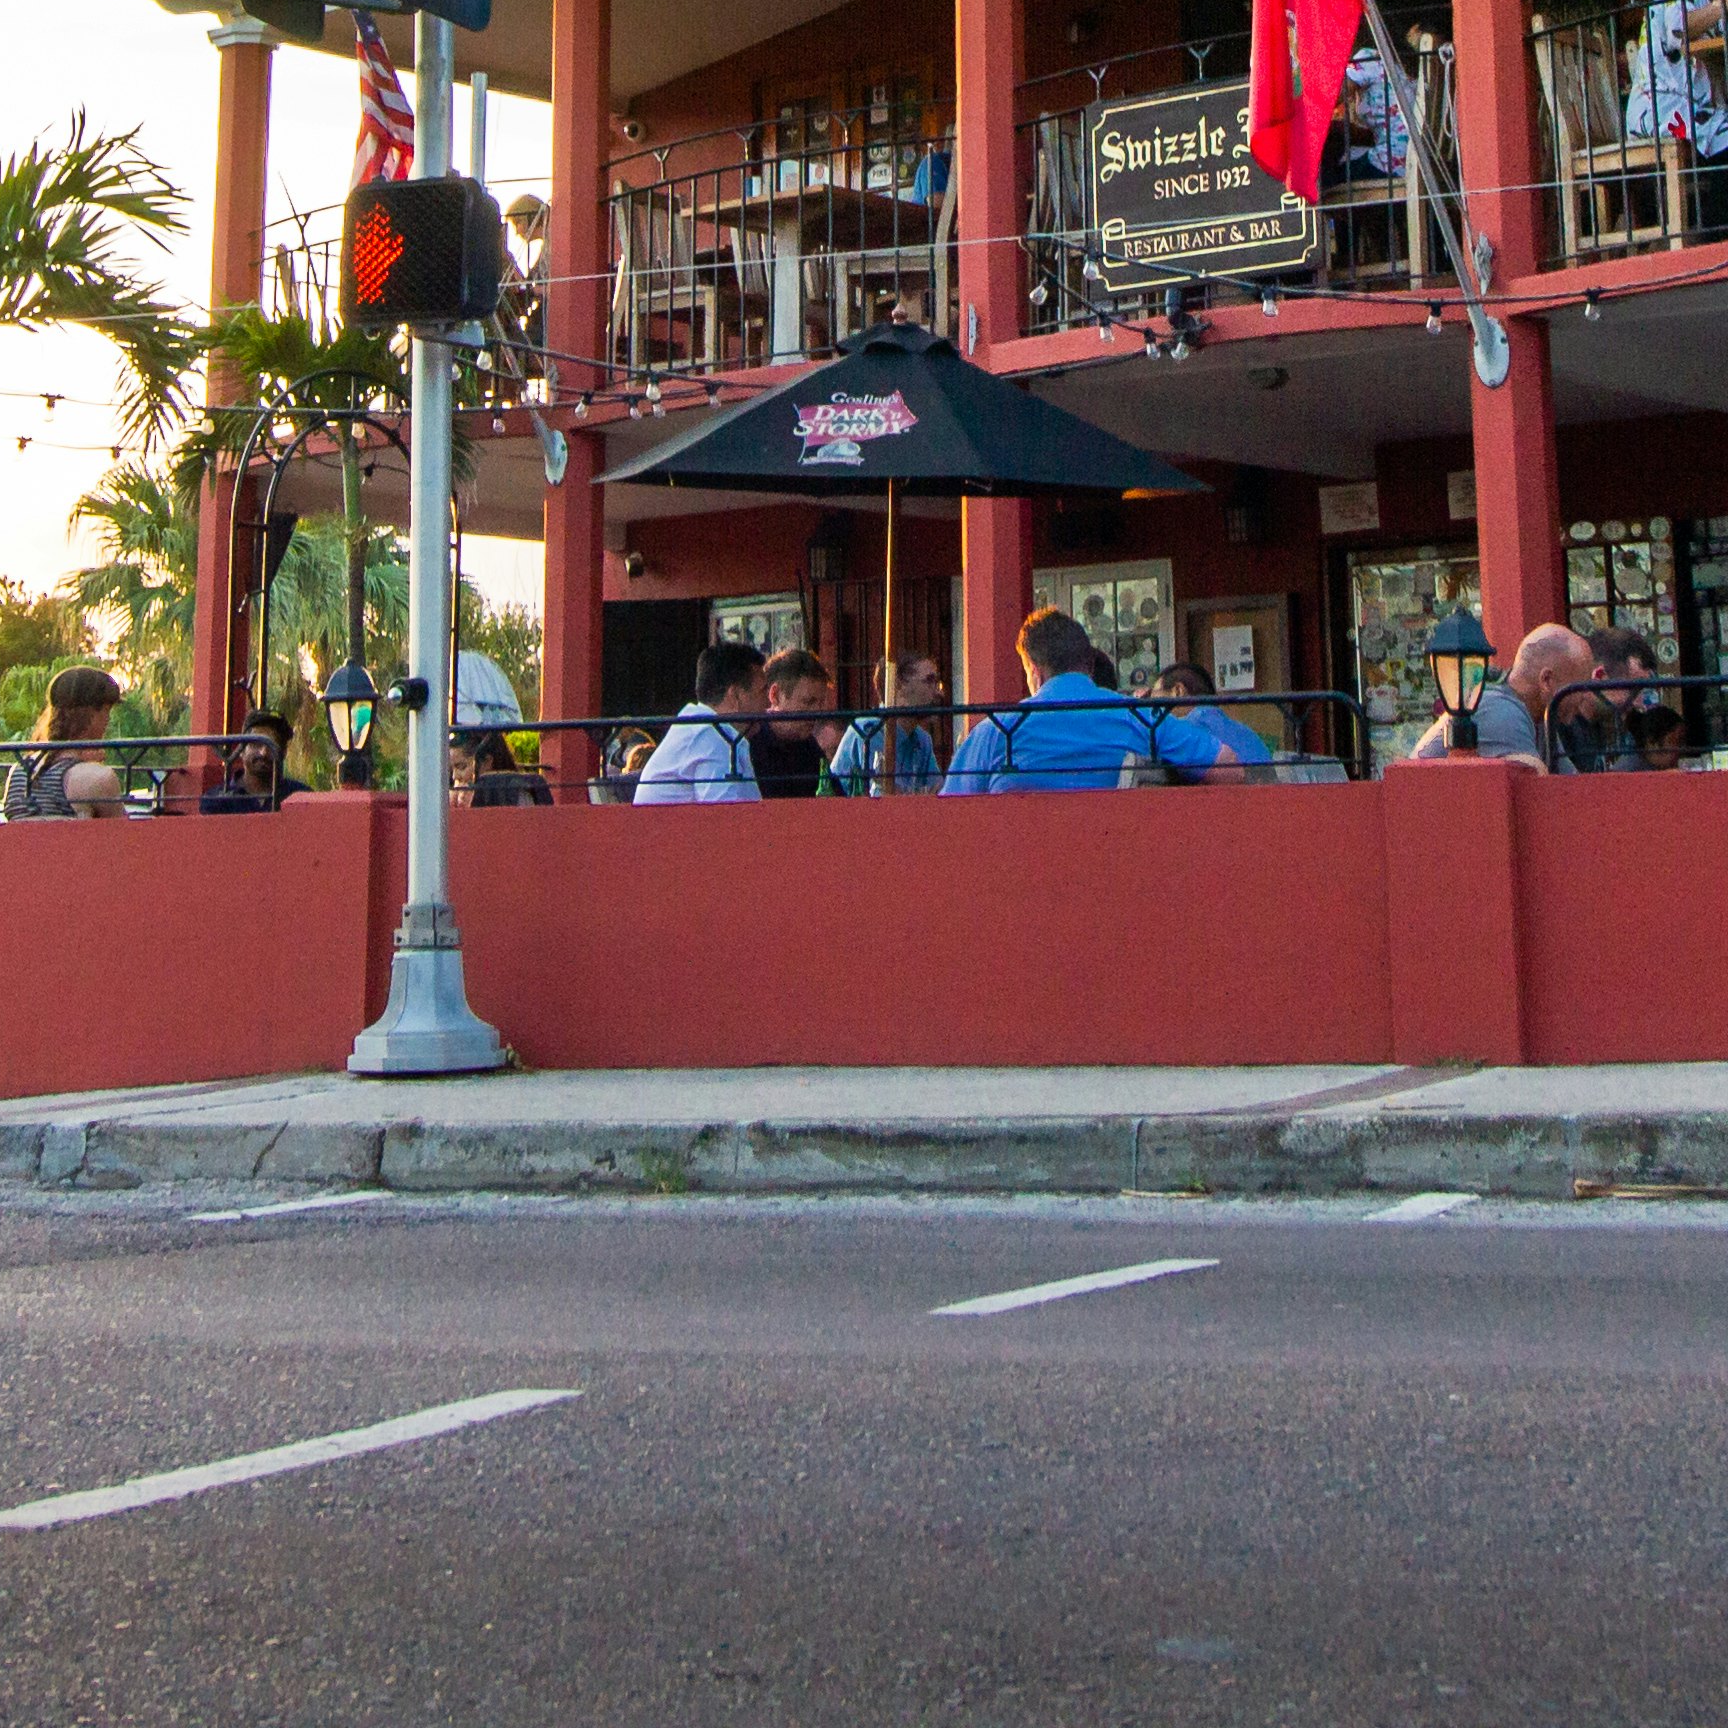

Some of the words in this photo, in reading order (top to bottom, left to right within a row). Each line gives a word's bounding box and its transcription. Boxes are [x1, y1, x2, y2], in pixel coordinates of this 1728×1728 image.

[1101, 115, 1226, 184] Swizzle
[1154, 172, 1209, 200] SINCE
[1216, 165, 1251, 191] 1932
[1124, 226, 1226, 258] RESTAURANT
[1230, 225, 1246, 242] &
[1250, 220, 1282, 241] BAR
[793, 420, 902, 437] STORMY
[813, 405, 886, 421] DARK
